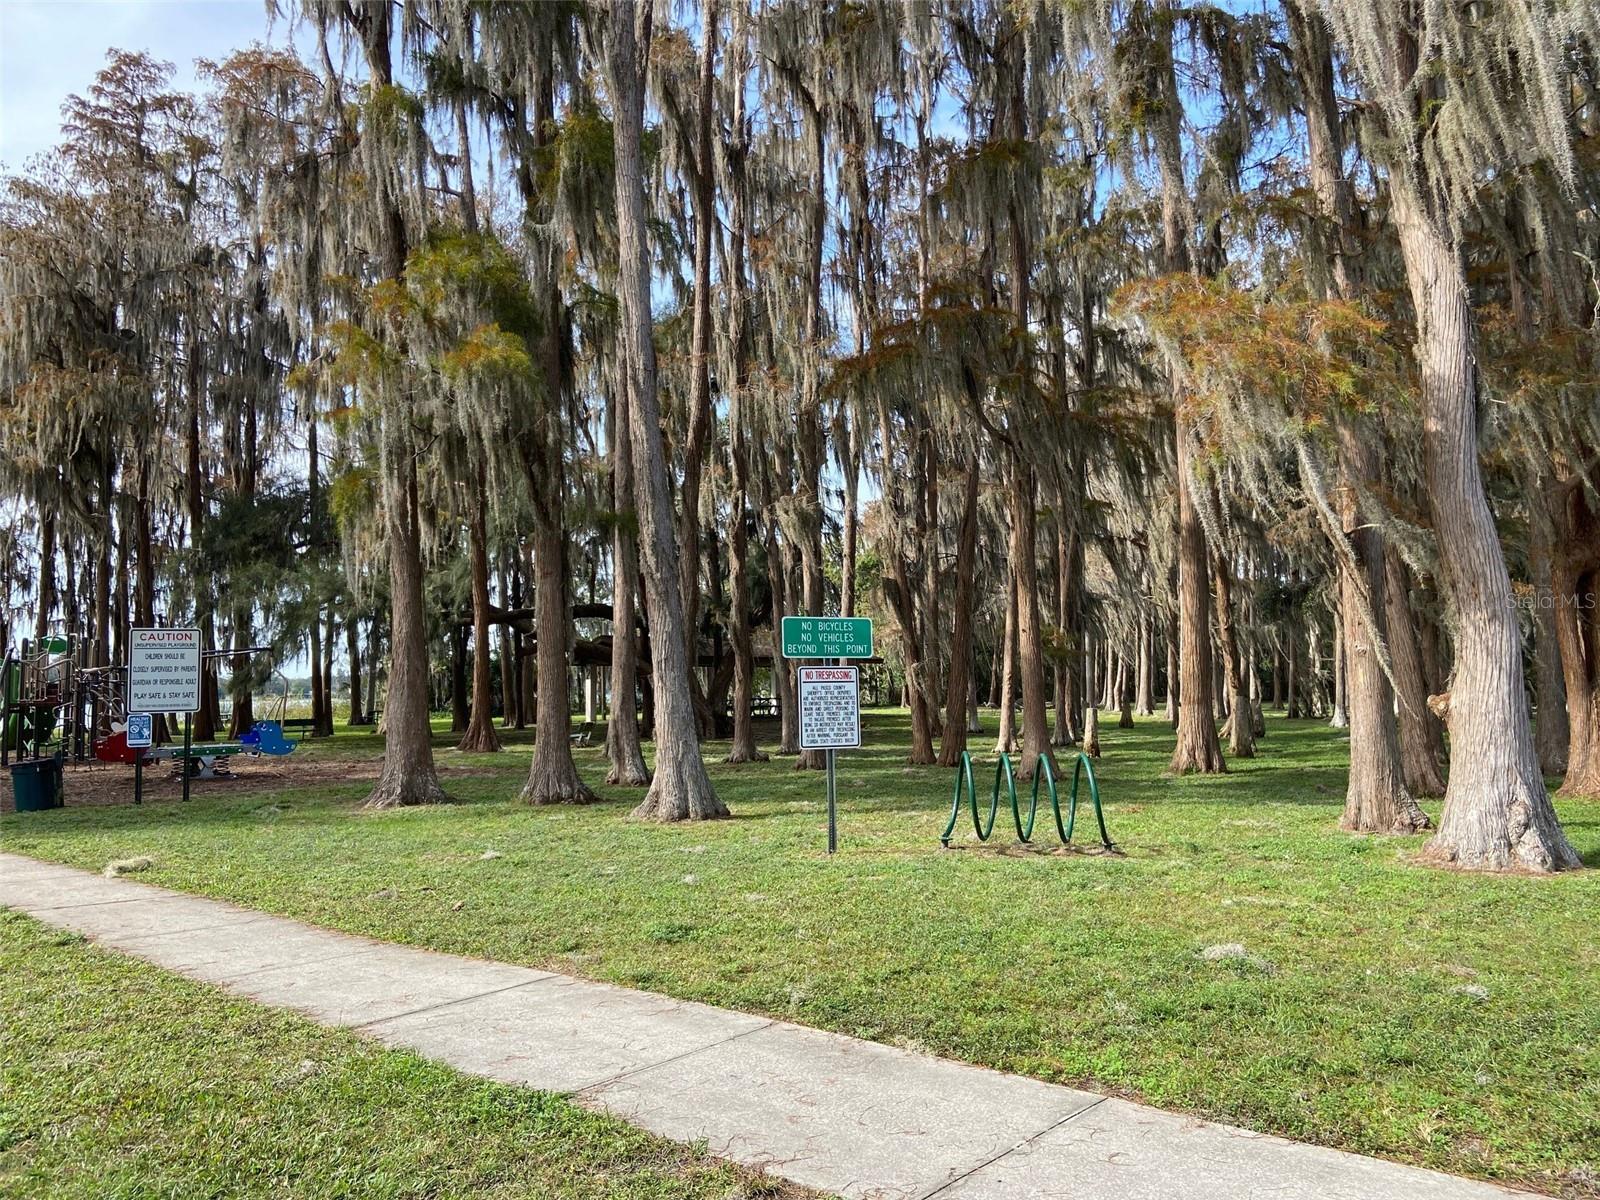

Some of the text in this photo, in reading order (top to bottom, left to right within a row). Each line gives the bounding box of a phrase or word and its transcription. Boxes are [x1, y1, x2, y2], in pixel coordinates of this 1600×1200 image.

[802, 622, 853, 631] NO BICYCLES
[801, 633, 854, 642] NO VEHICLES
[788, 644, 868, 653] BEYOND THIS POINT
[805, 671, 852, 680] NO TRESPASSING
